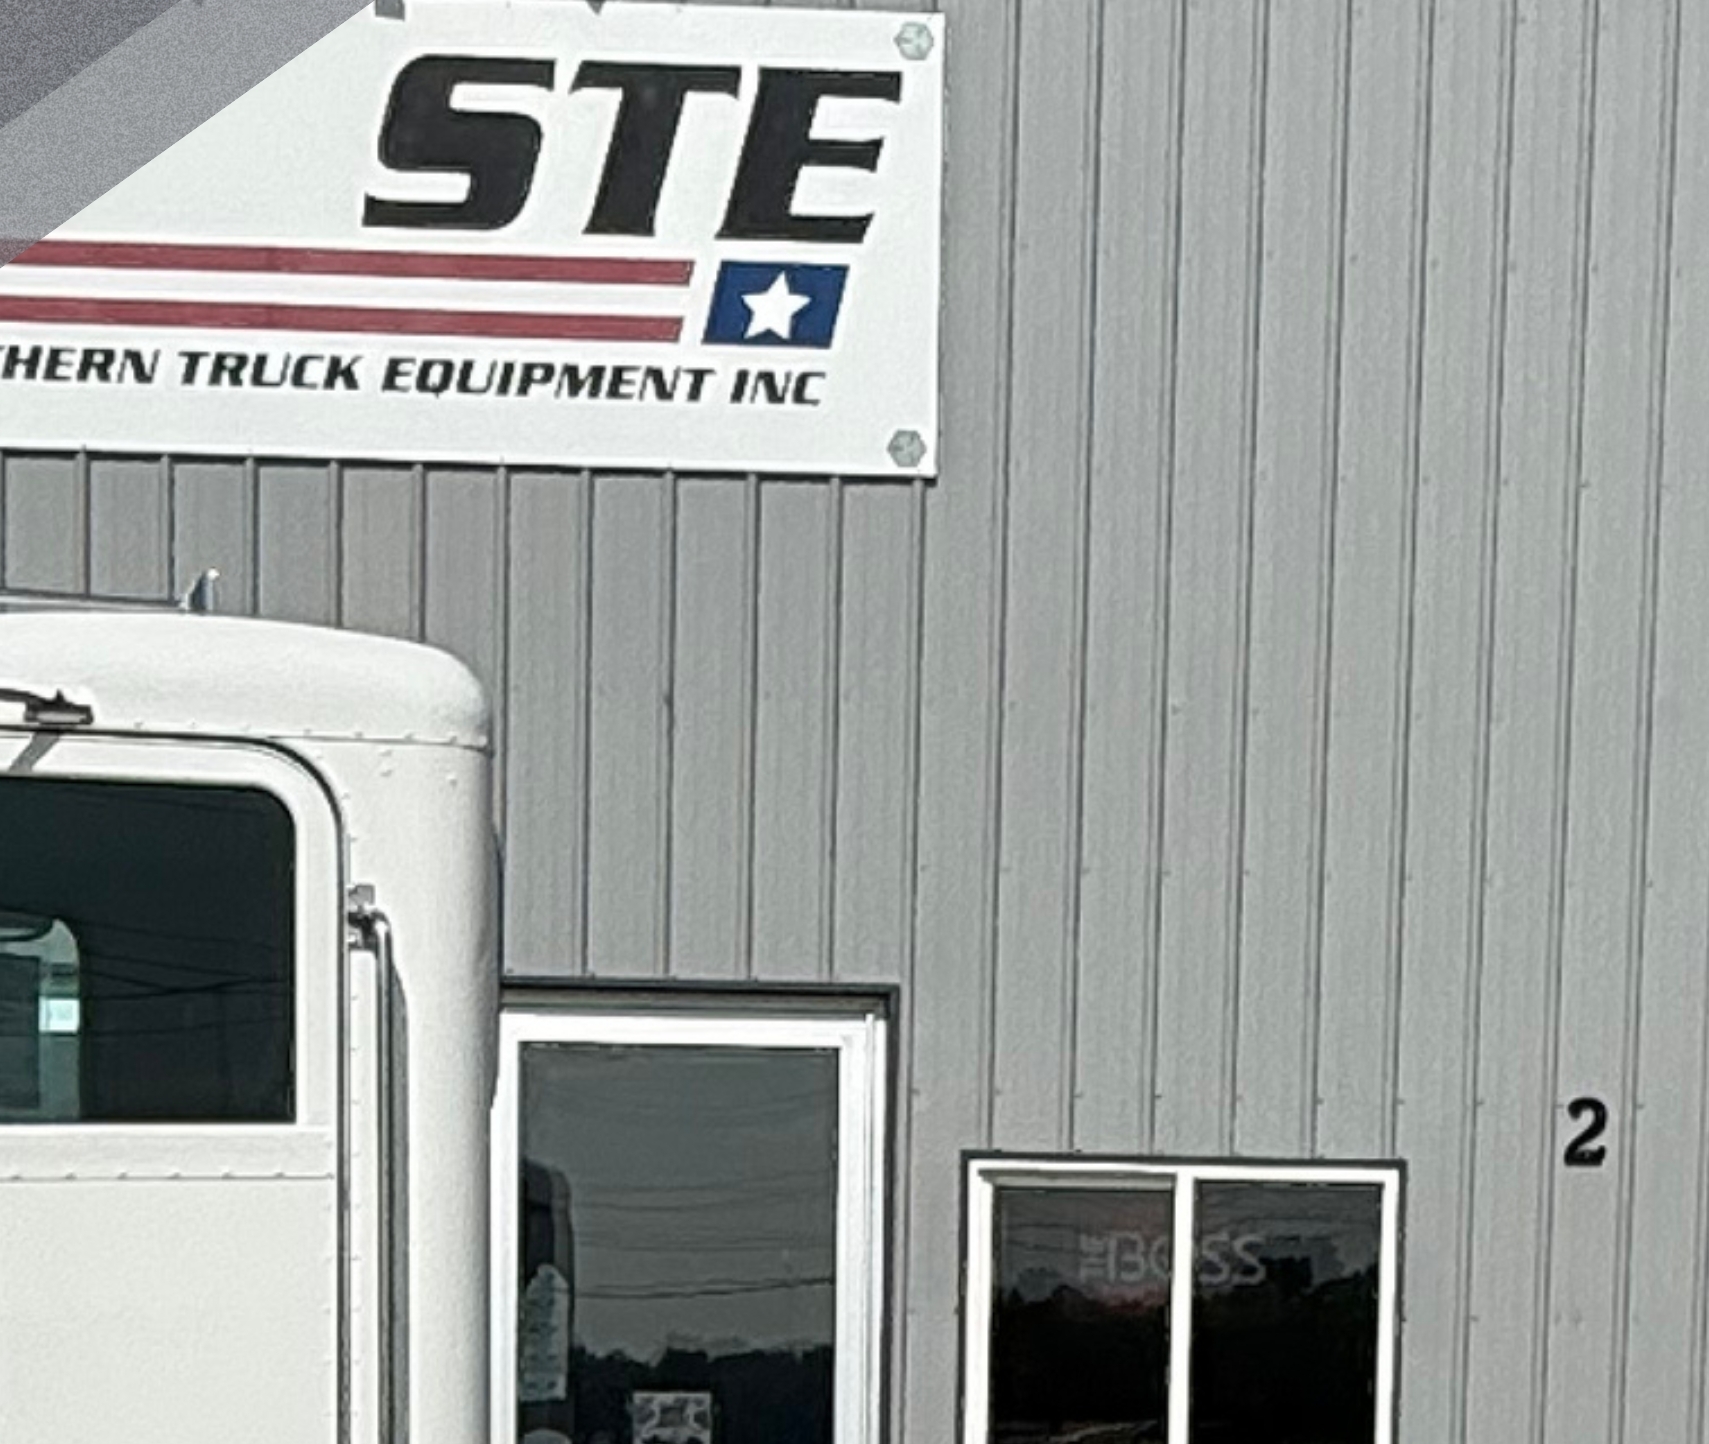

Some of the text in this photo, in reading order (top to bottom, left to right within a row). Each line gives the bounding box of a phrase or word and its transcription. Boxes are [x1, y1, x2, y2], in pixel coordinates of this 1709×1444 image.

[361, 52, 904, 244] STE
[178, 350, 363, 392] TRUCK
[380, 356, 716, 404] EQUIPMENT
[729, 368, 827, 407] INC
[1563, 1096, 1608, 1167] 2
